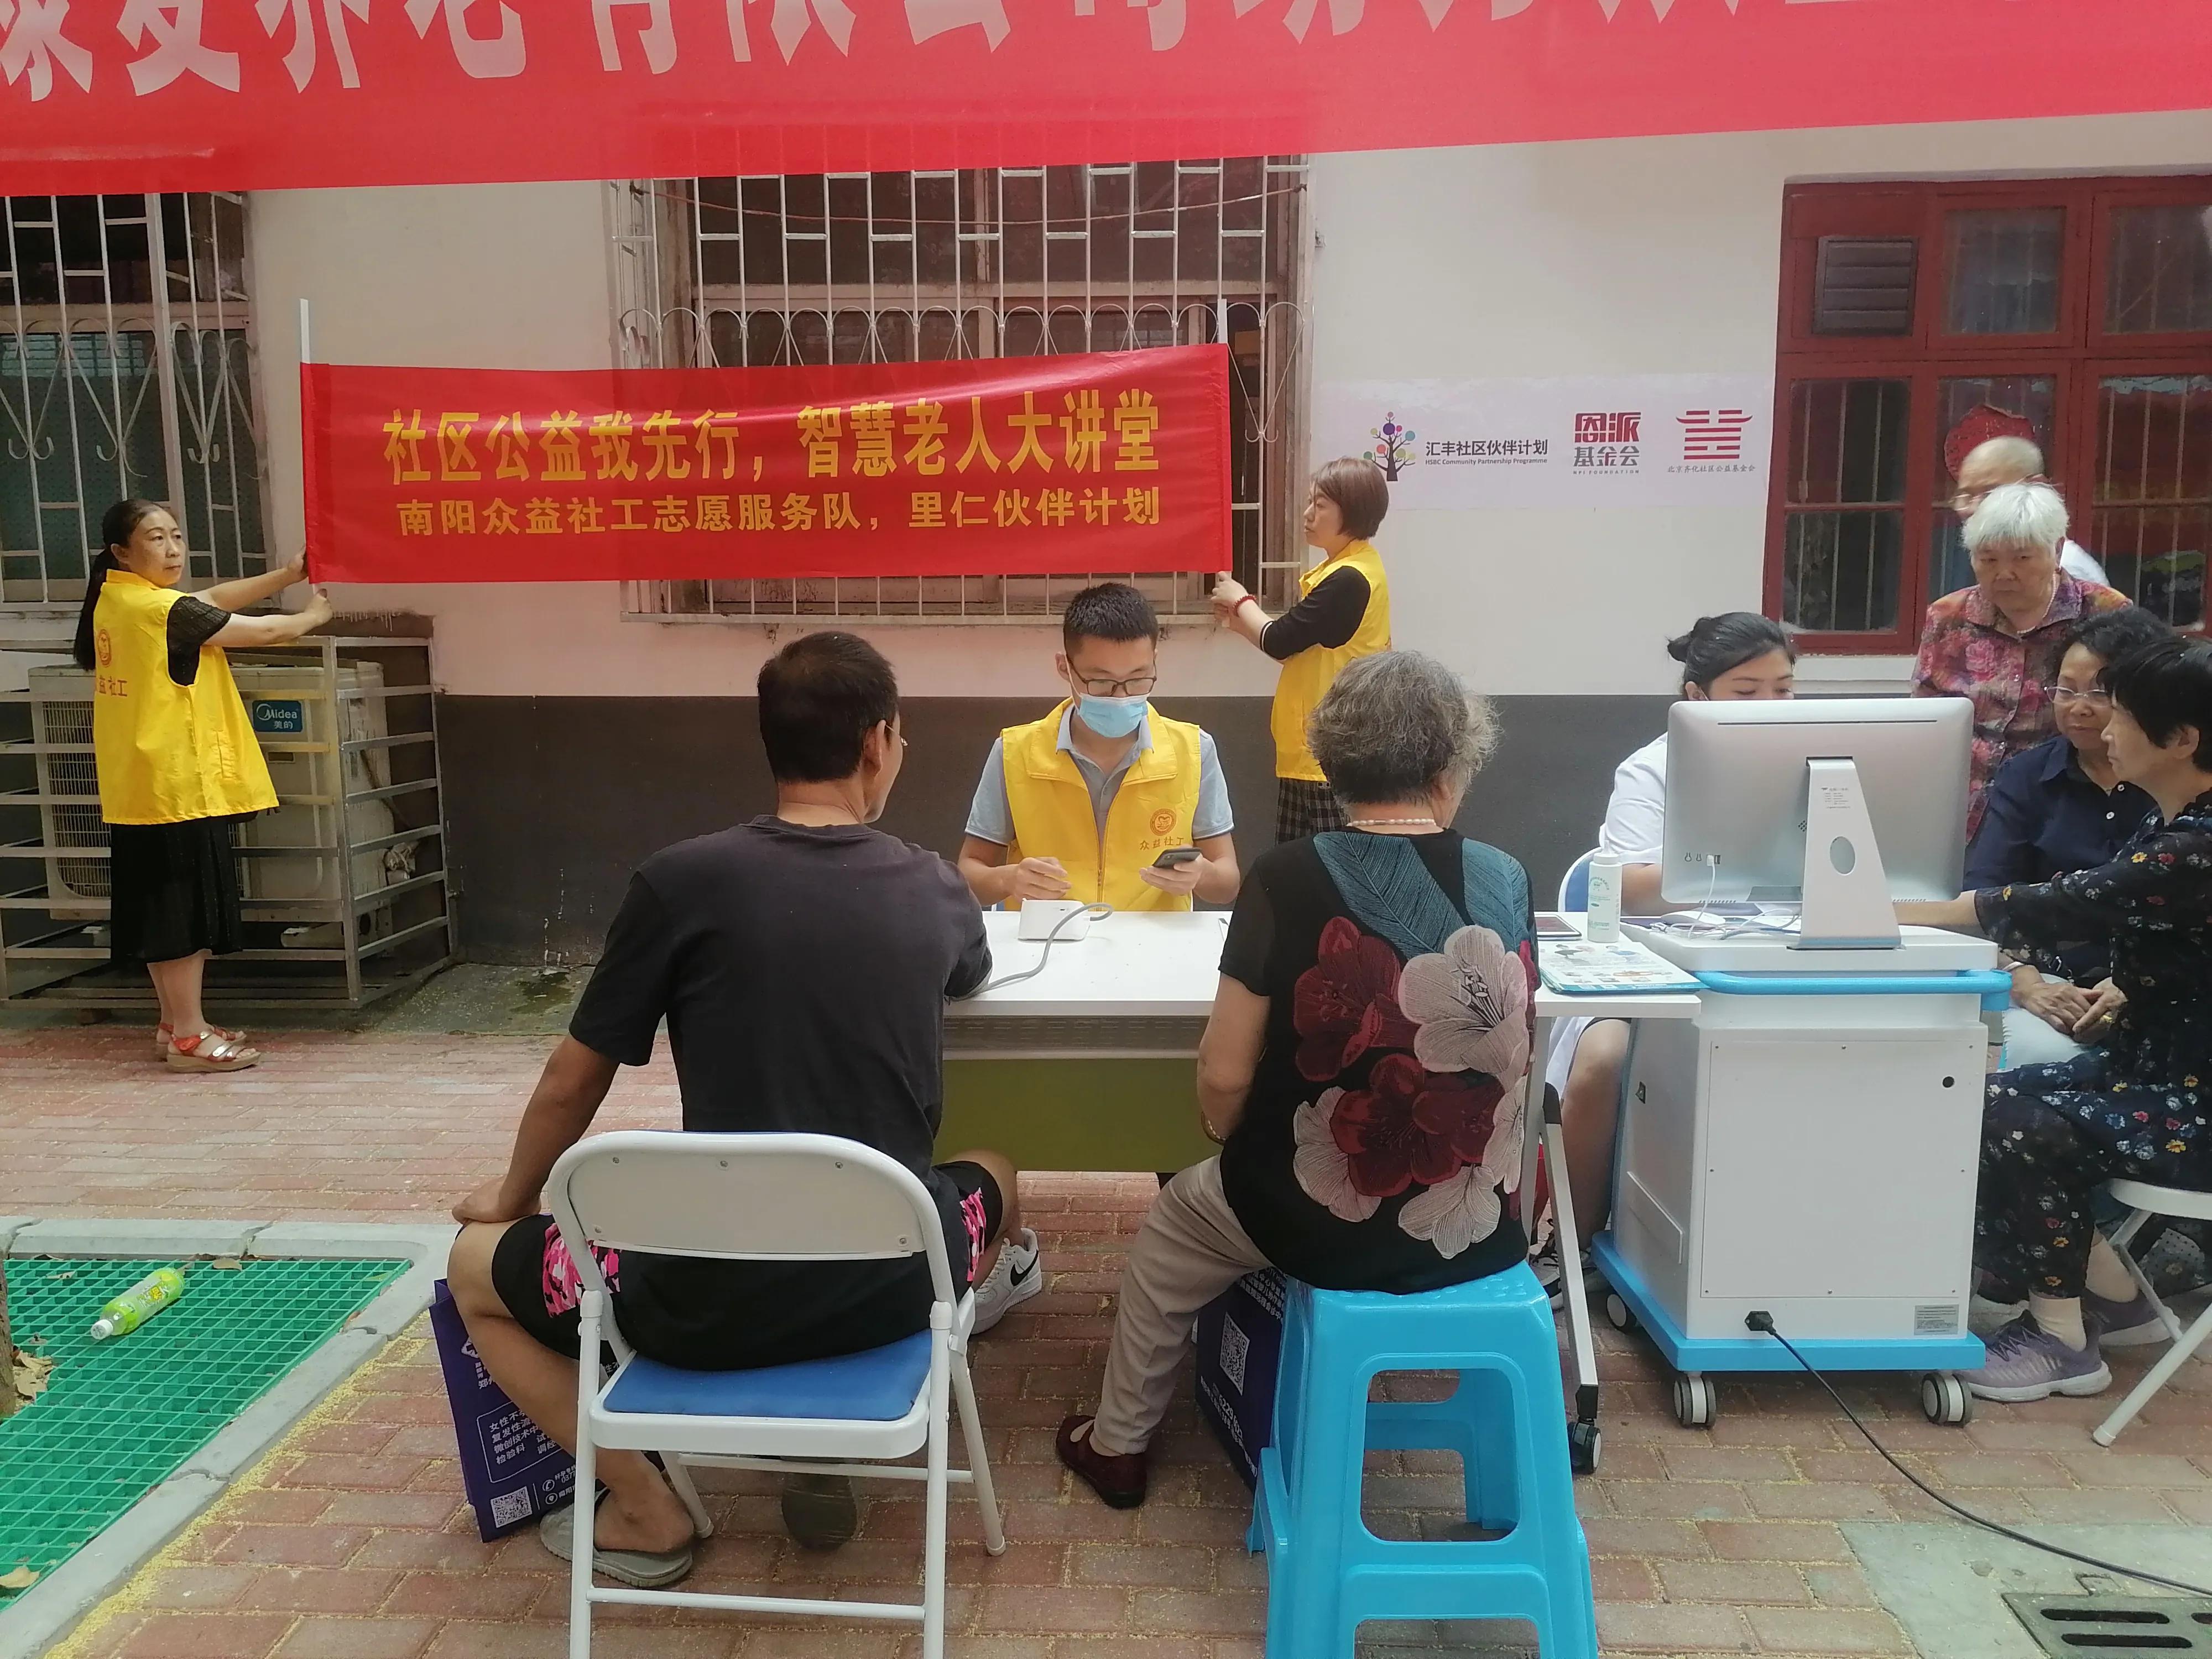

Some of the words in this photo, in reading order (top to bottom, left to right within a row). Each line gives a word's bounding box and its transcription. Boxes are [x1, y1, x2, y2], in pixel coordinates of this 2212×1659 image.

[1426, 439, 1548, 456] 汇丰社区伙伴计划
[1573, 446, 1640, 467] 基金会
[1667, 465, 1756, 473] 北京齐化社区公益基金会
[264, 708, 298, 719] Midea
[274, 721, 294, 729] 美的
